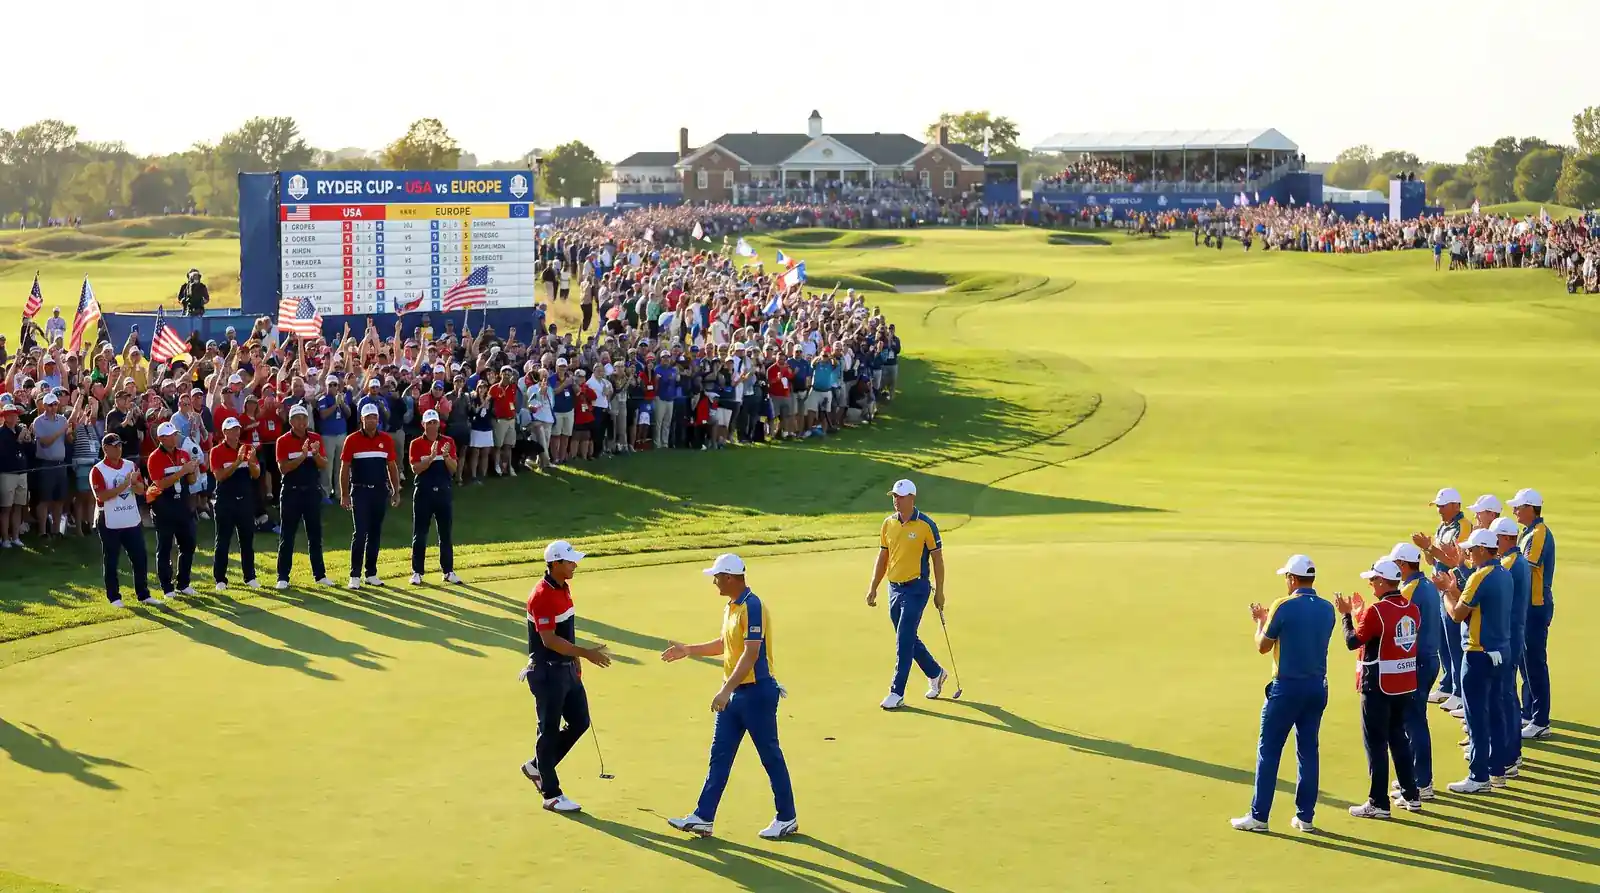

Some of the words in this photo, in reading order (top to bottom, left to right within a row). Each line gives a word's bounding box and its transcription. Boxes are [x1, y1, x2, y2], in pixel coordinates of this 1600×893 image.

[317, 180, 363, 194] RYDER
[366, 180, 394, 194] CUP
[405, 180, 432, 194] USA
[451, 180, 502, 194] EUROPE
[343, 208, 362, 217] USA
[435, 207, 471, 216] EUROPE
